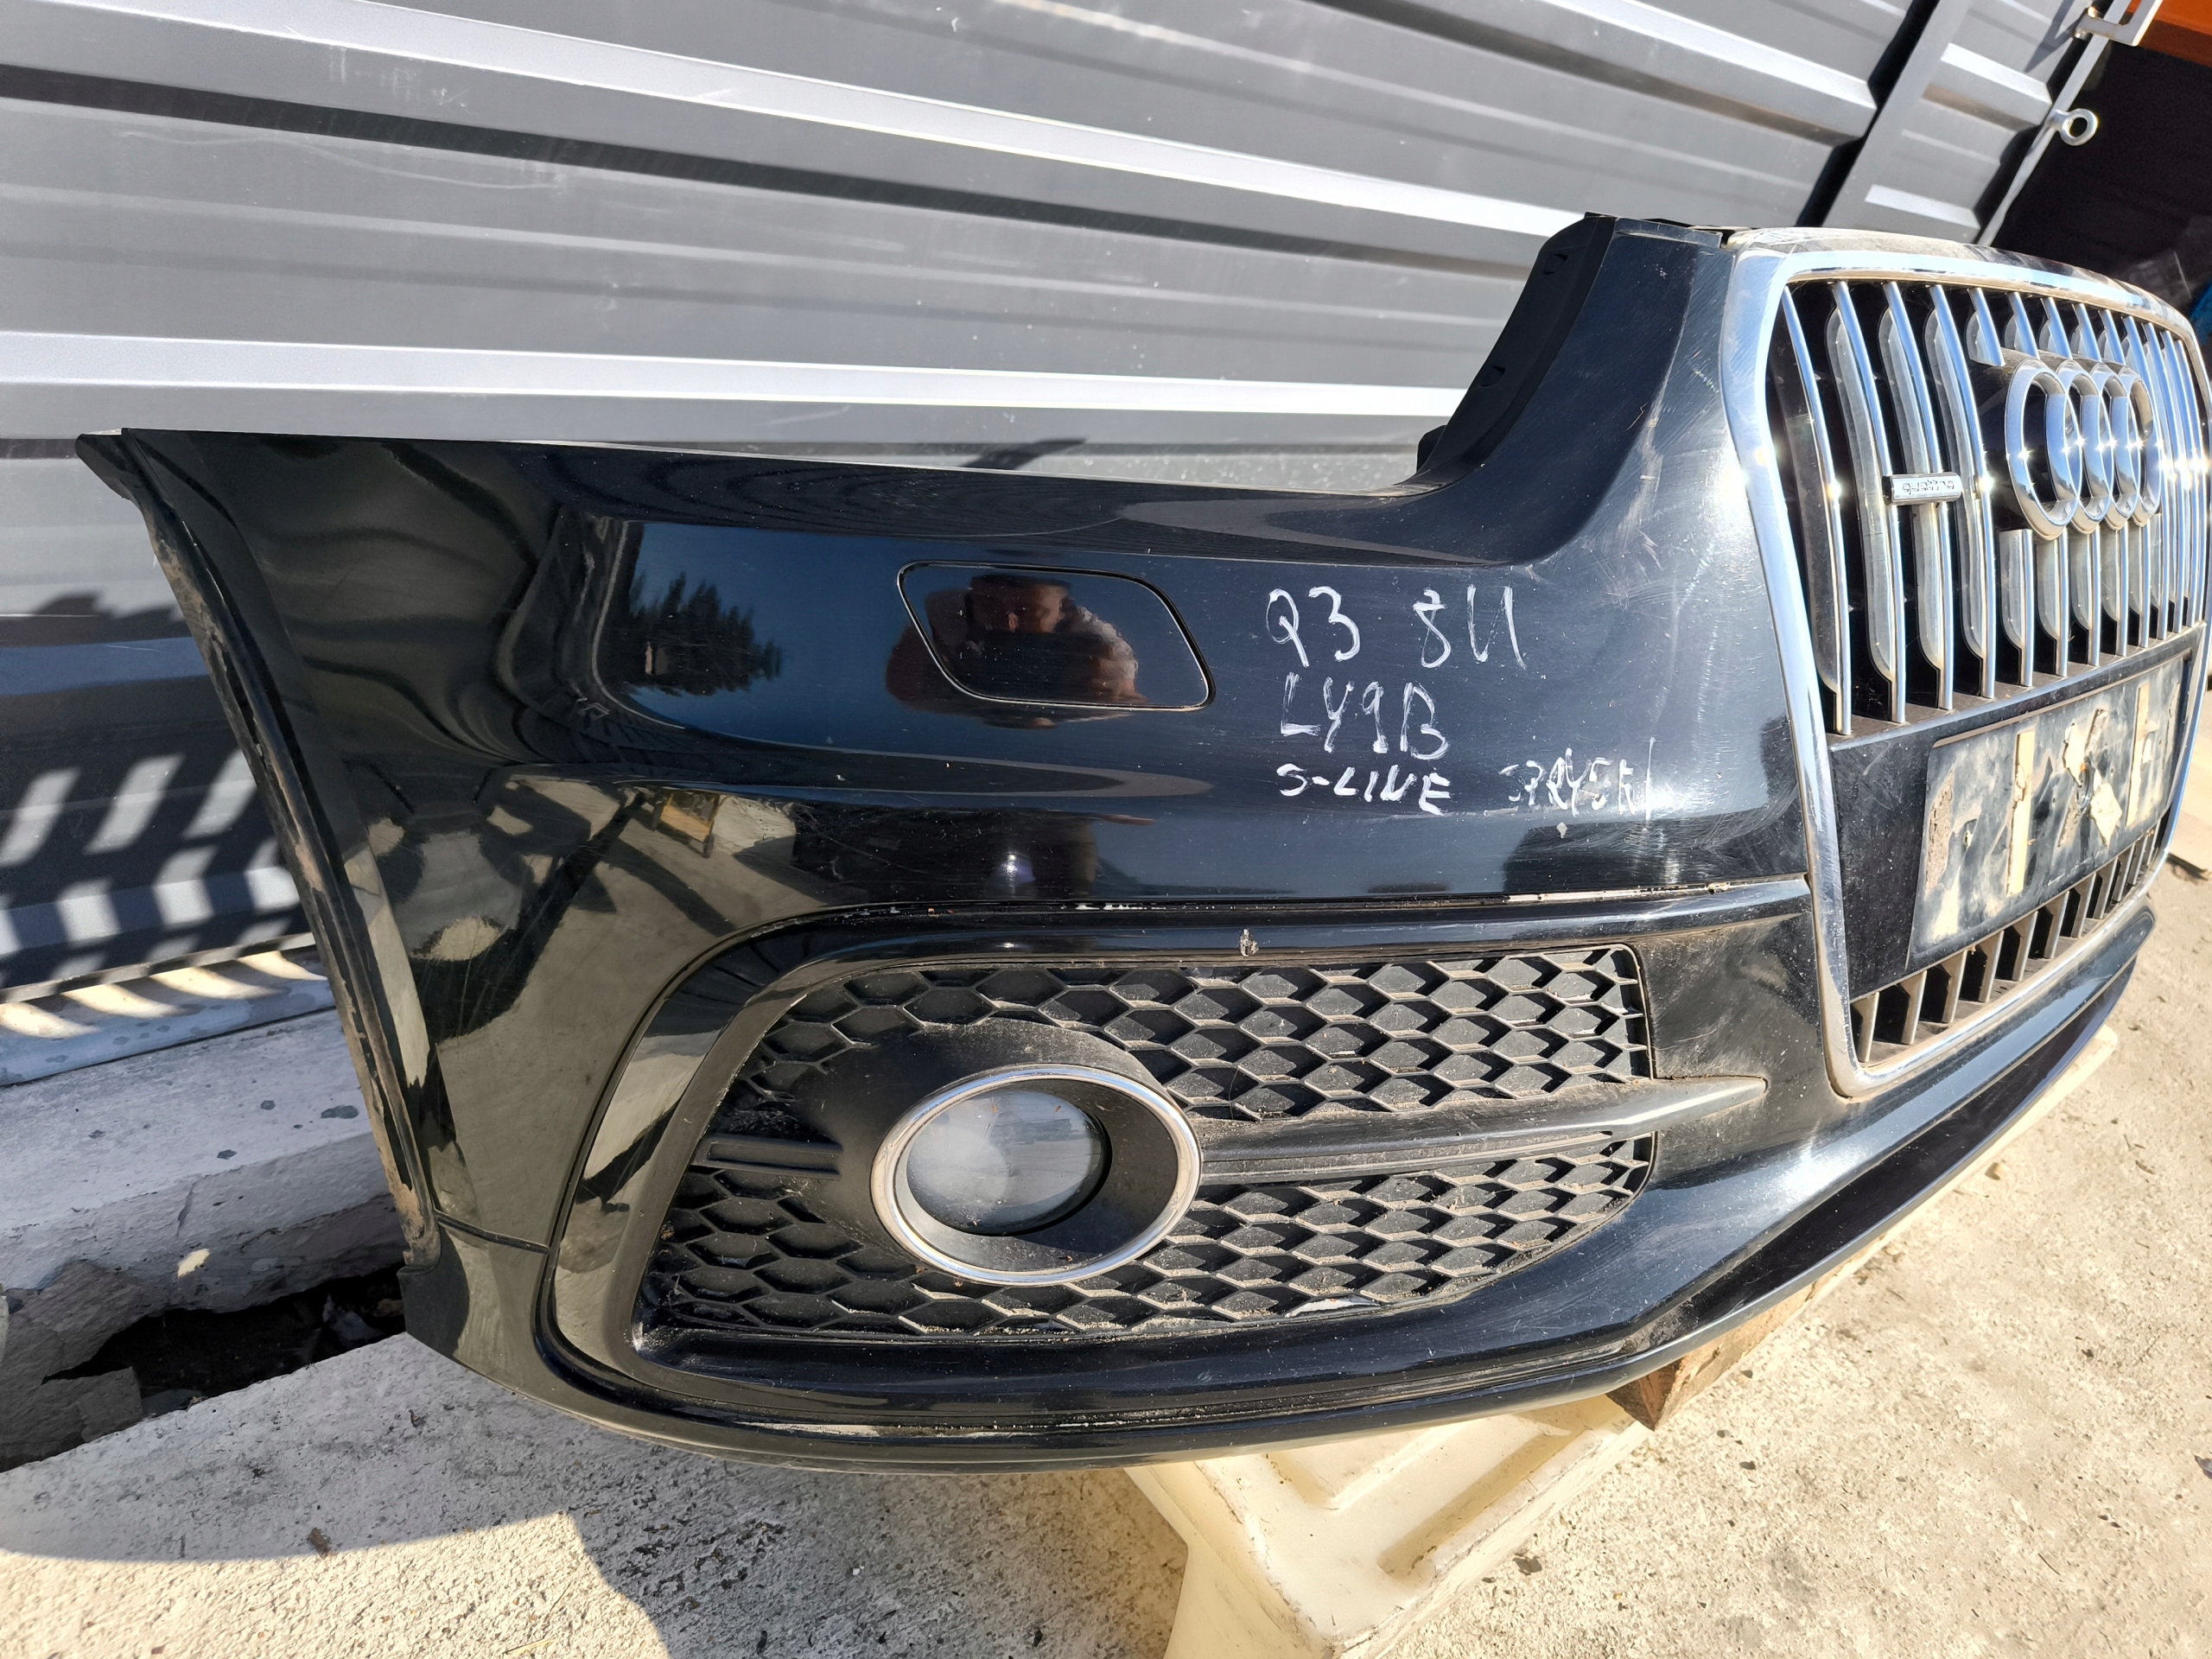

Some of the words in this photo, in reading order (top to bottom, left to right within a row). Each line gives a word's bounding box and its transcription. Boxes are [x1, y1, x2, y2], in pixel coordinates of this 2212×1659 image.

[1902, 480, 1955, 495] quattro
[1266, 586, 1361, 668] Q3
[1412, 586, 1528, 670] 8U
